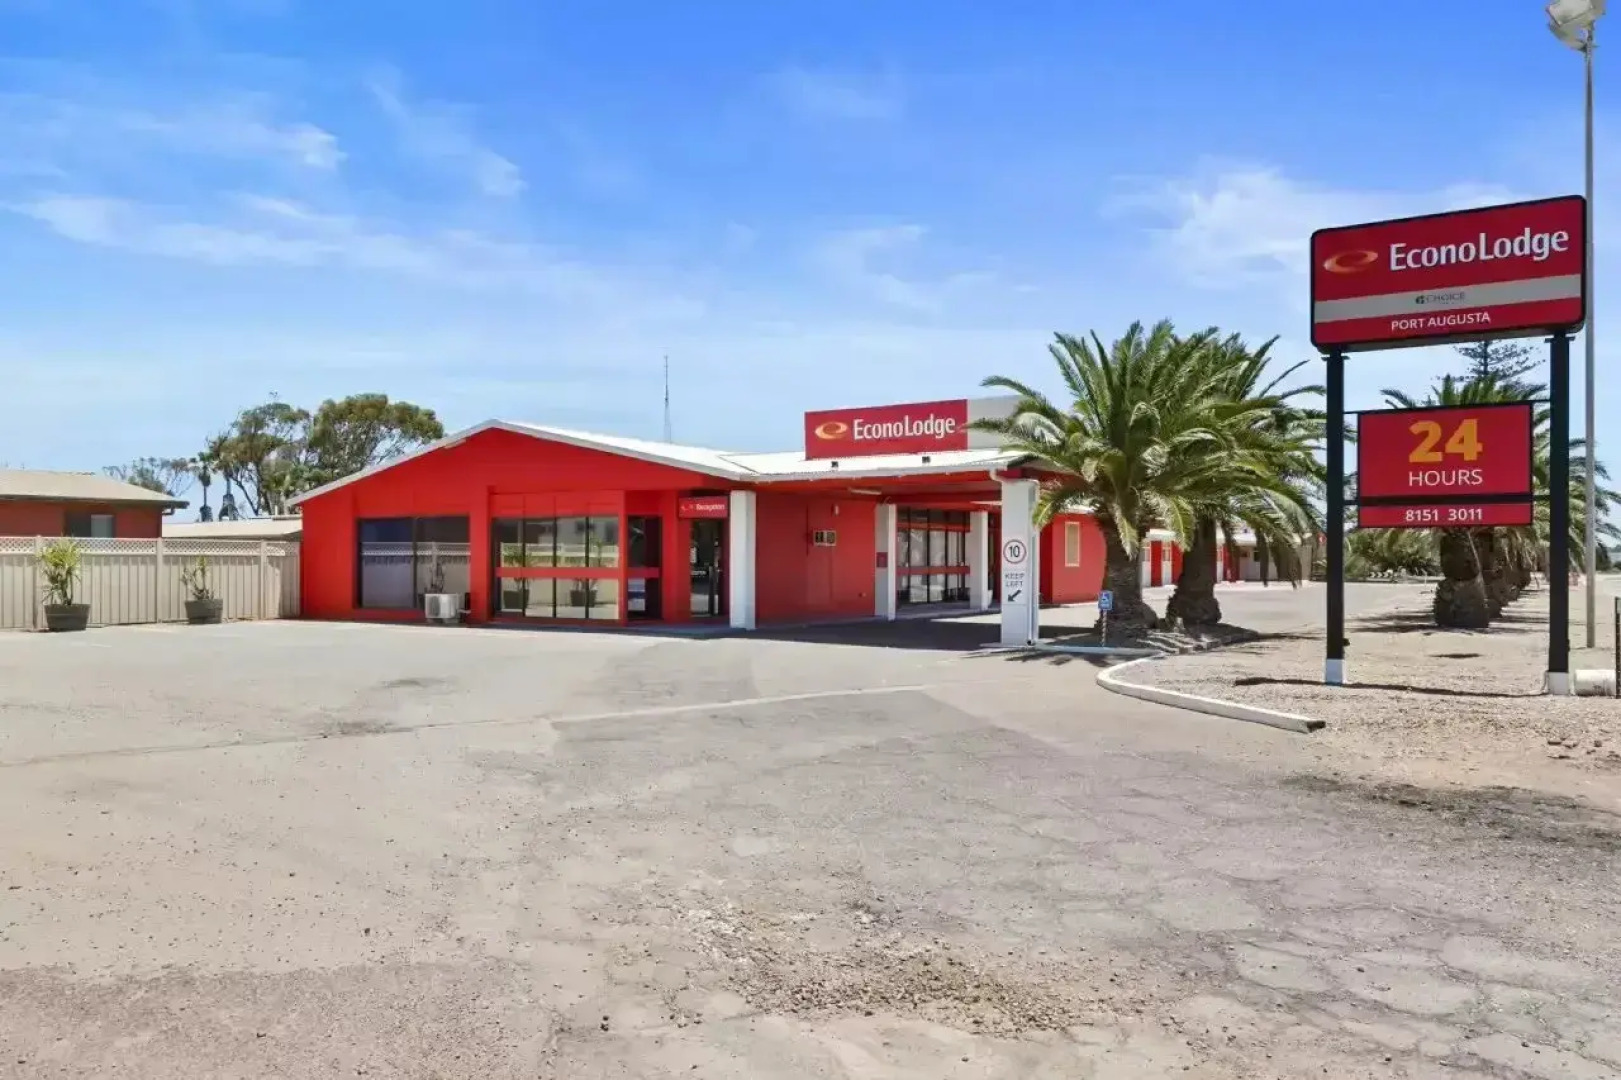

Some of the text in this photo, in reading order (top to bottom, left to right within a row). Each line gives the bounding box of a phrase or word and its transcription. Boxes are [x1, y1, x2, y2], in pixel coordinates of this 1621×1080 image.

[1389, 227, 1569, 271] EconoLodge
[1391, 311, 1491, 331] PORT AUGUSTA
[853, 413, 956, 440] EconoLodge
[1408, 418, 1484, 463] 24
[1408, 469, 1484, 487] HOURS
[1405, 508, 1483, 522] 8151 3011
[1008, 545, 1021, 558] 10
[1004, 572, 1025, 580] KEEP
[1004, 580, 1023, 588] LEFT
